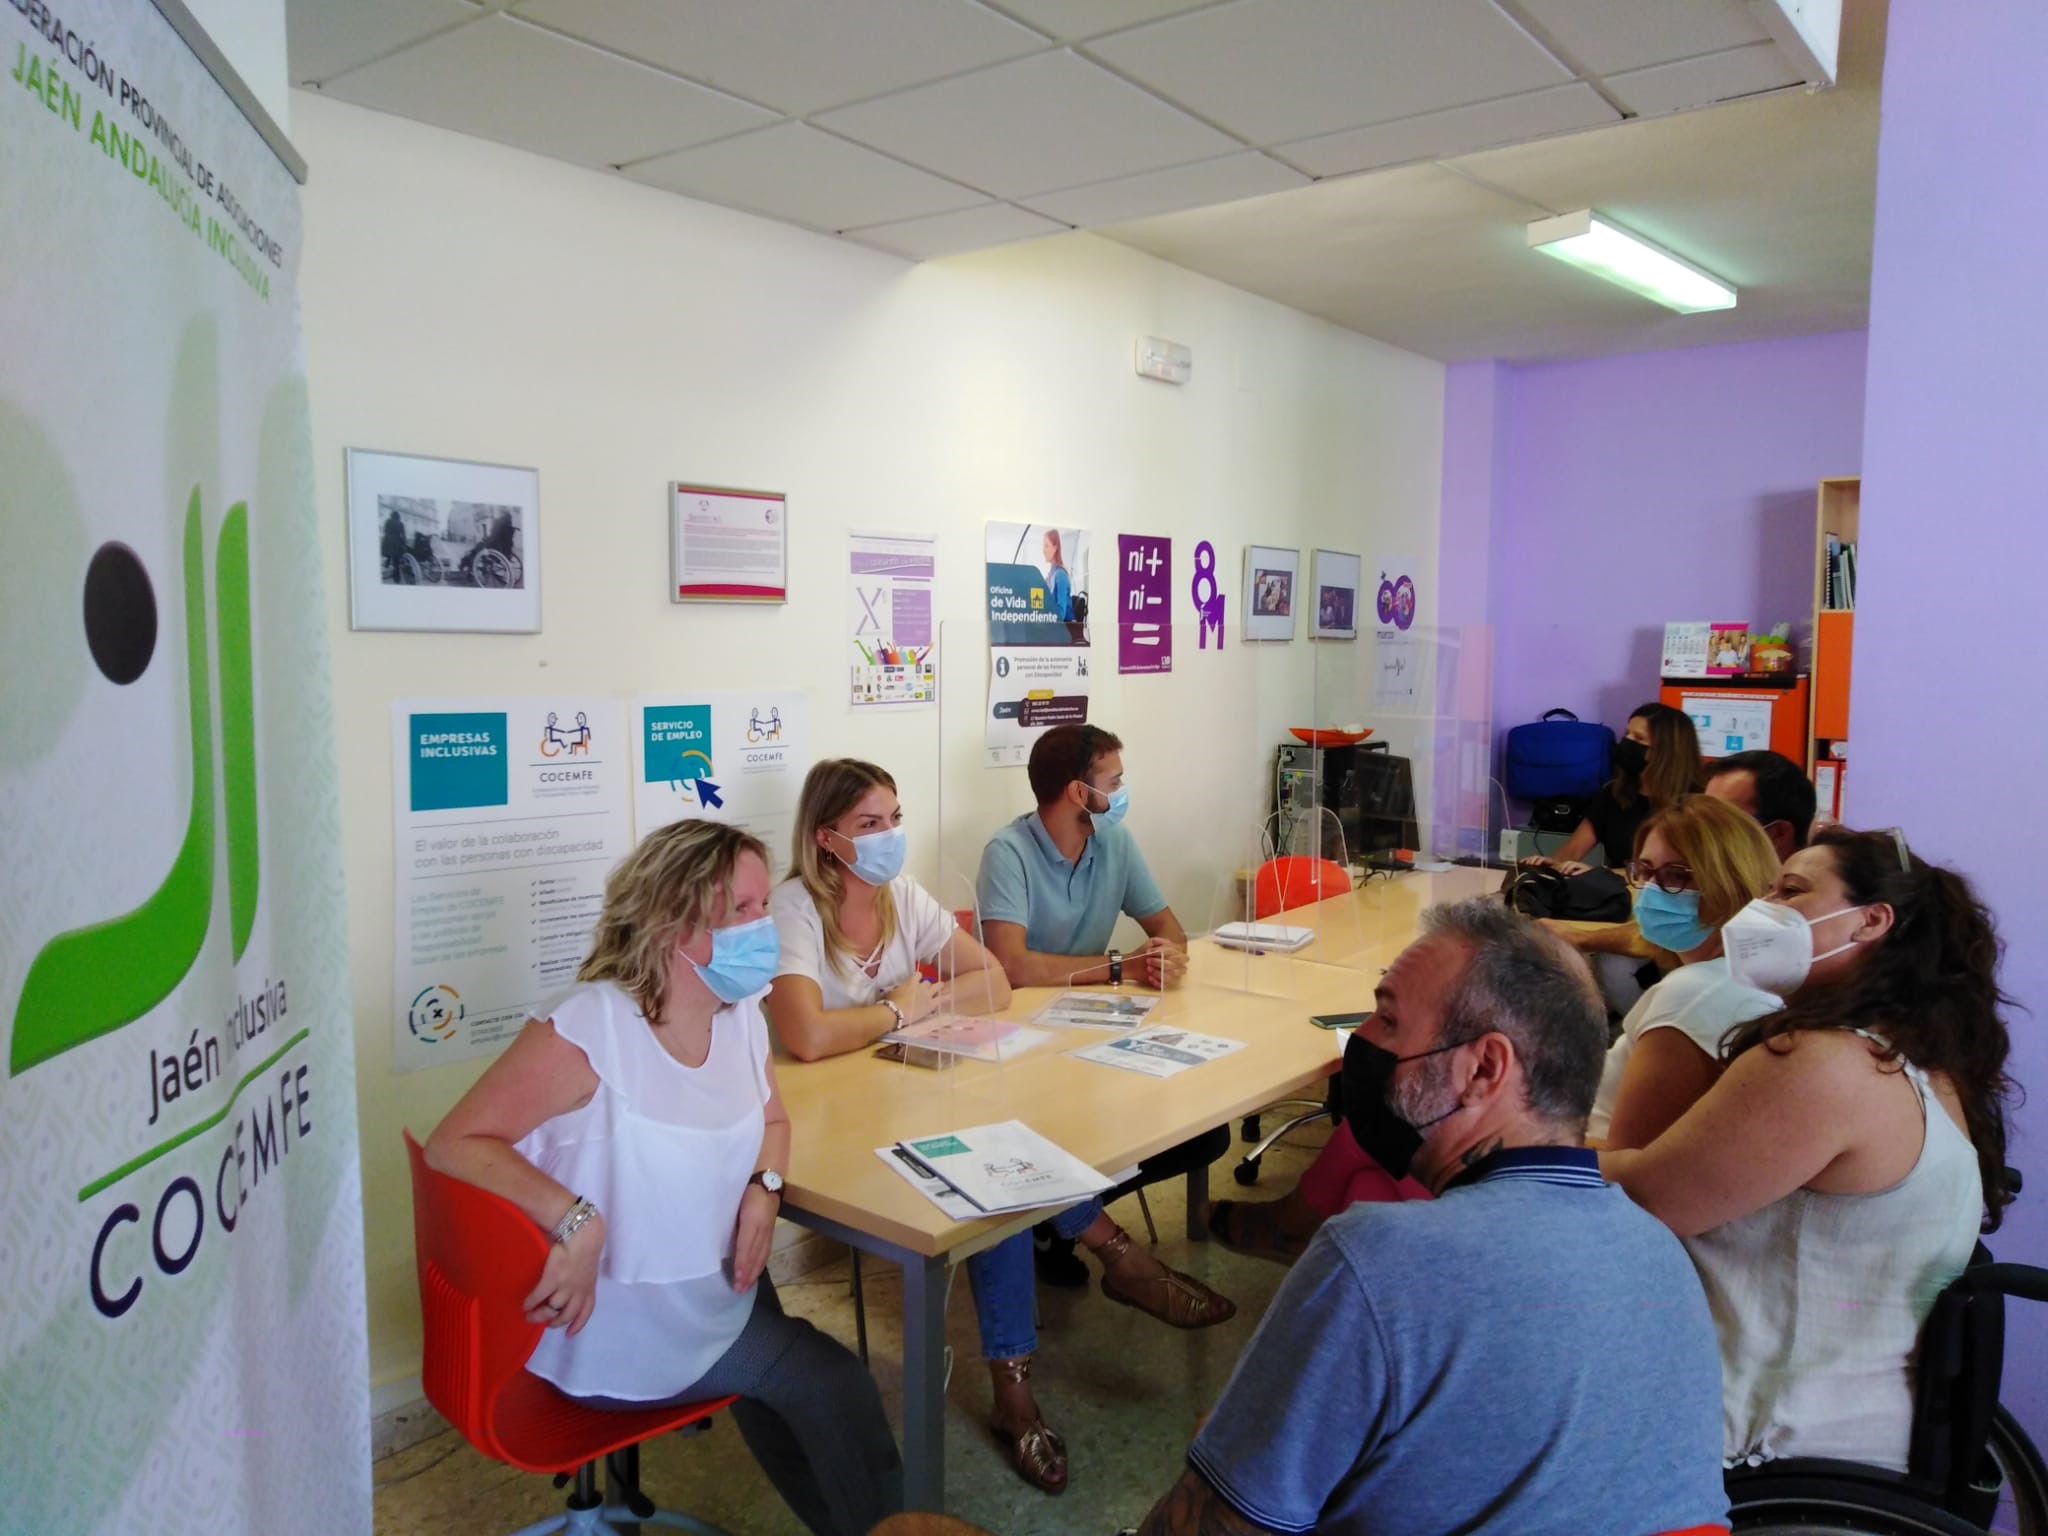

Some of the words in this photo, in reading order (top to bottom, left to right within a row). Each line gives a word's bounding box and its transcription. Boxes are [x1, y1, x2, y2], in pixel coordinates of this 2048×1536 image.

[12, 41, 81, 132] JAÉN
[90, 110, 202, 239] ANDALUCÍA
[197, 163, 214, 197] DE
[990, 586, 1013, 595] Oficina
[990, 597, 1003, 608] de
[1004, 597, 1027, 609] Vida
[991, 610, 1058, 624] Independiente
[651, 720, 694, 731] SERVICIO
[420, 731, 490, 745] EMPRESAS
[651, 732, 664, 742] DE
[666, 730, 703, 741] EMPLEO
[421, 745, 497, 758] INCLUSIVAS
[746, 752, 783, 763] COCEMFE
[539, 770, 593, 783] COCEMFE
[415, 839, 428, 852] El
[430, 836, 457, 850] valor
[462, 836, 475, 848] de
[478, 834, 489, 846] la
[491, 828, 560, 845] colaboración
[415, 856, 438, 869] con
[441, 853, 458, 866] las
[460, 848, 511, 866] personas
[513, 847, 533, 859] con
[536, 839, 603, 857] discapacidad
[149, 1028, 220, 1125] Jaén
[225, 977, 287, 1052] nclusiva
[90, 1064, 312, 1319] COCEMFE
